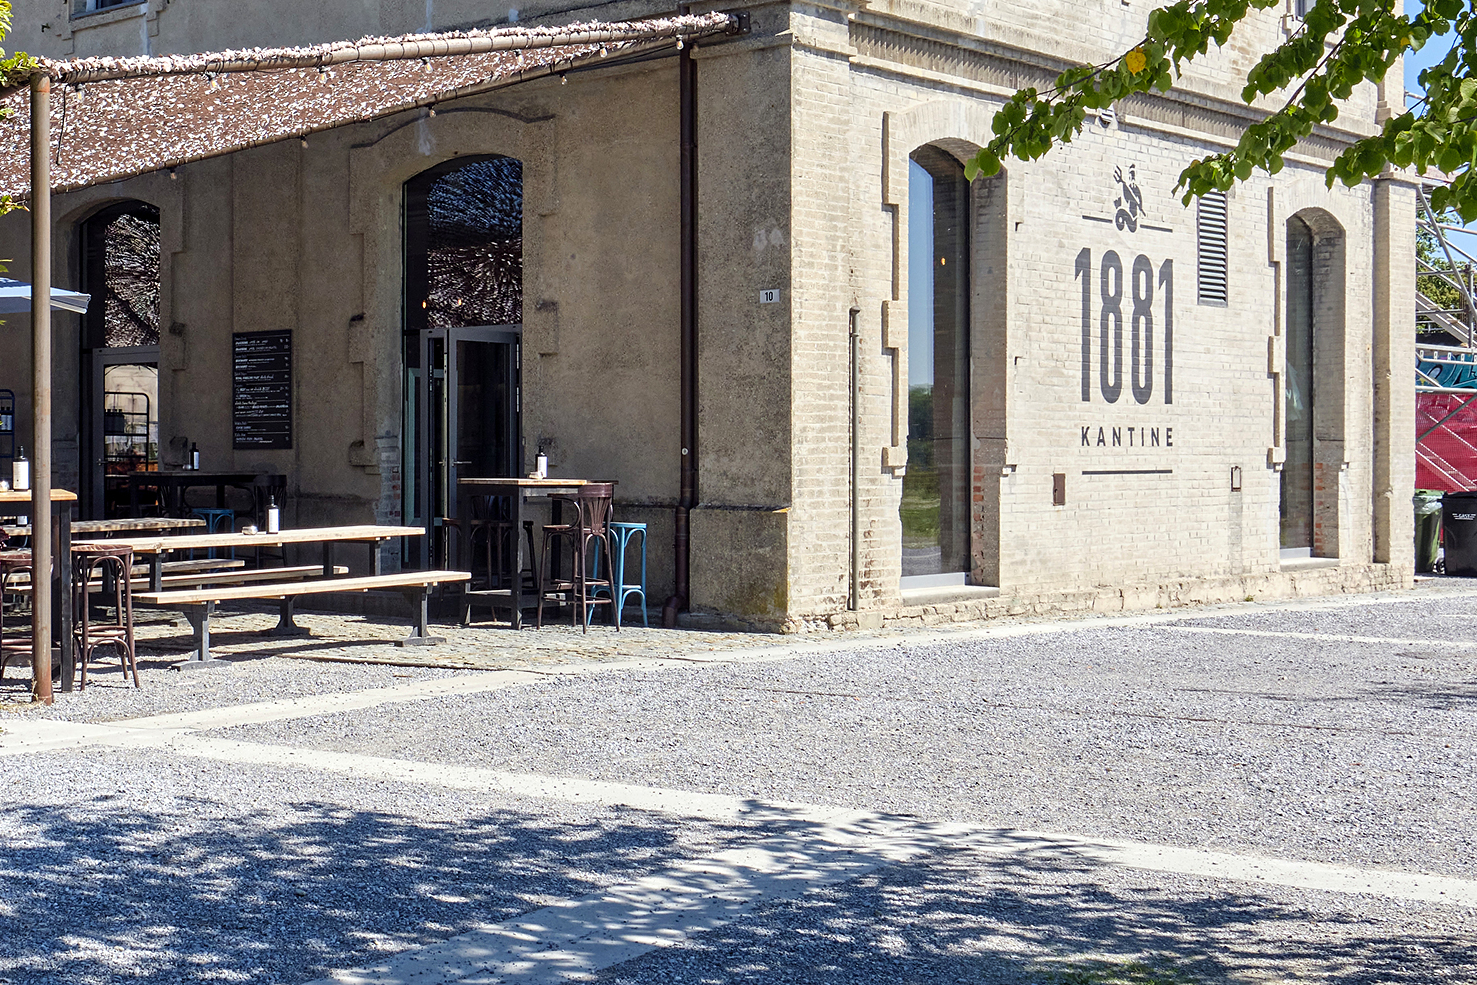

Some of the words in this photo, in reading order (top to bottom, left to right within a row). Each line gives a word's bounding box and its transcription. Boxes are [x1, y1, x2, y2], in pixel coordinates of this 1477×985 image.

[765, 291, 774, 302] 10
[1075, 247, 1173, 404] 1881
[1081, 425, 1173, 447] KANTINE
